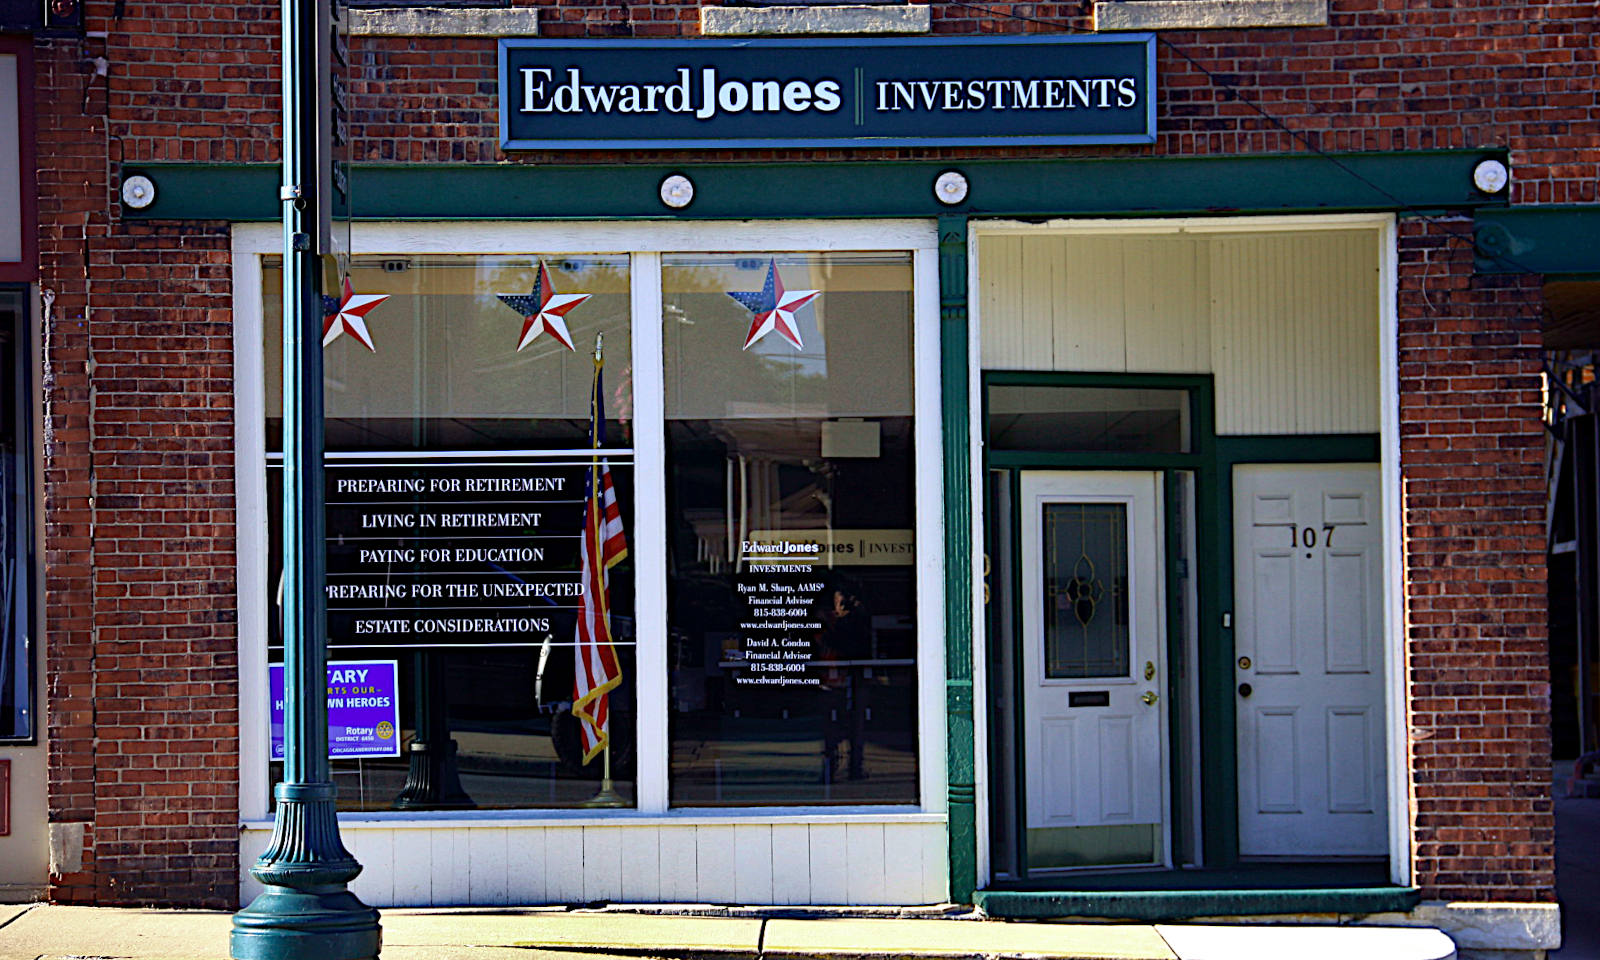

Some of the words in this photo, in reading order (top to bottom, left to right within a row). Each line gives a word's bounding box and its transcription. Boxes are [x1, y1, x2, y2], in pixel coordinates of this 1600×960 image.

[877, 79, 1135, 109] INVESTMENTS
[337, 478, 426, 493] PREPARING
[430, 478, 461, 493] FOR
[465, 477, 566, 492] RETIREMENT
[362, 514, 416, 528] LIVING
[420, 513, 437, 528] IN
[441, 513, 542, 528] RETIREMENT
[1290, 526, 1335, 548] 107
[360, 549, 416, 563] PAYING
[420, 548, 451, 563] FOR
[455, 547, 544, 562] EDUCATION
[749, 564, 813, 573] INVESTMENTS
[326, 584, 406, 598] REPARING
[411, 584, 443, 598] FOR
[445, 583, 479, 598] THE
[483, 583, 584, 598] UNEXPECTED
[737, 583, 757, 594] Ryan
[758, 582, 769, 592] M.
[770, 583, 796, 595] Sharp,
[748, 595, 783, 605] Financial
[785, 595, 814, 605] Advisor
[753, 607, 808, 617] 815-838-6004
[355, 619, 411, 634] ESTATE
[413, 618, 550, 633] CONSIDERATIONS
[740, 619, 822, 632] www.edwardjones.com
[746, 637, 770, 647] David
[770, 638, 780, 647] A.
[781, 638, 811, 647] Condon
[745, 650, 781, 660] Financial
[782, 650, 812, 660] Advisor
[750, 663, 806, 672] 815-838-6004
[327, 668, 369, 684] ARY
[736, 675, 820, 687] www.edwardjones.com
[346, 696, 391, 708] HEROES
[345, 726, 375, 736] Rotary
